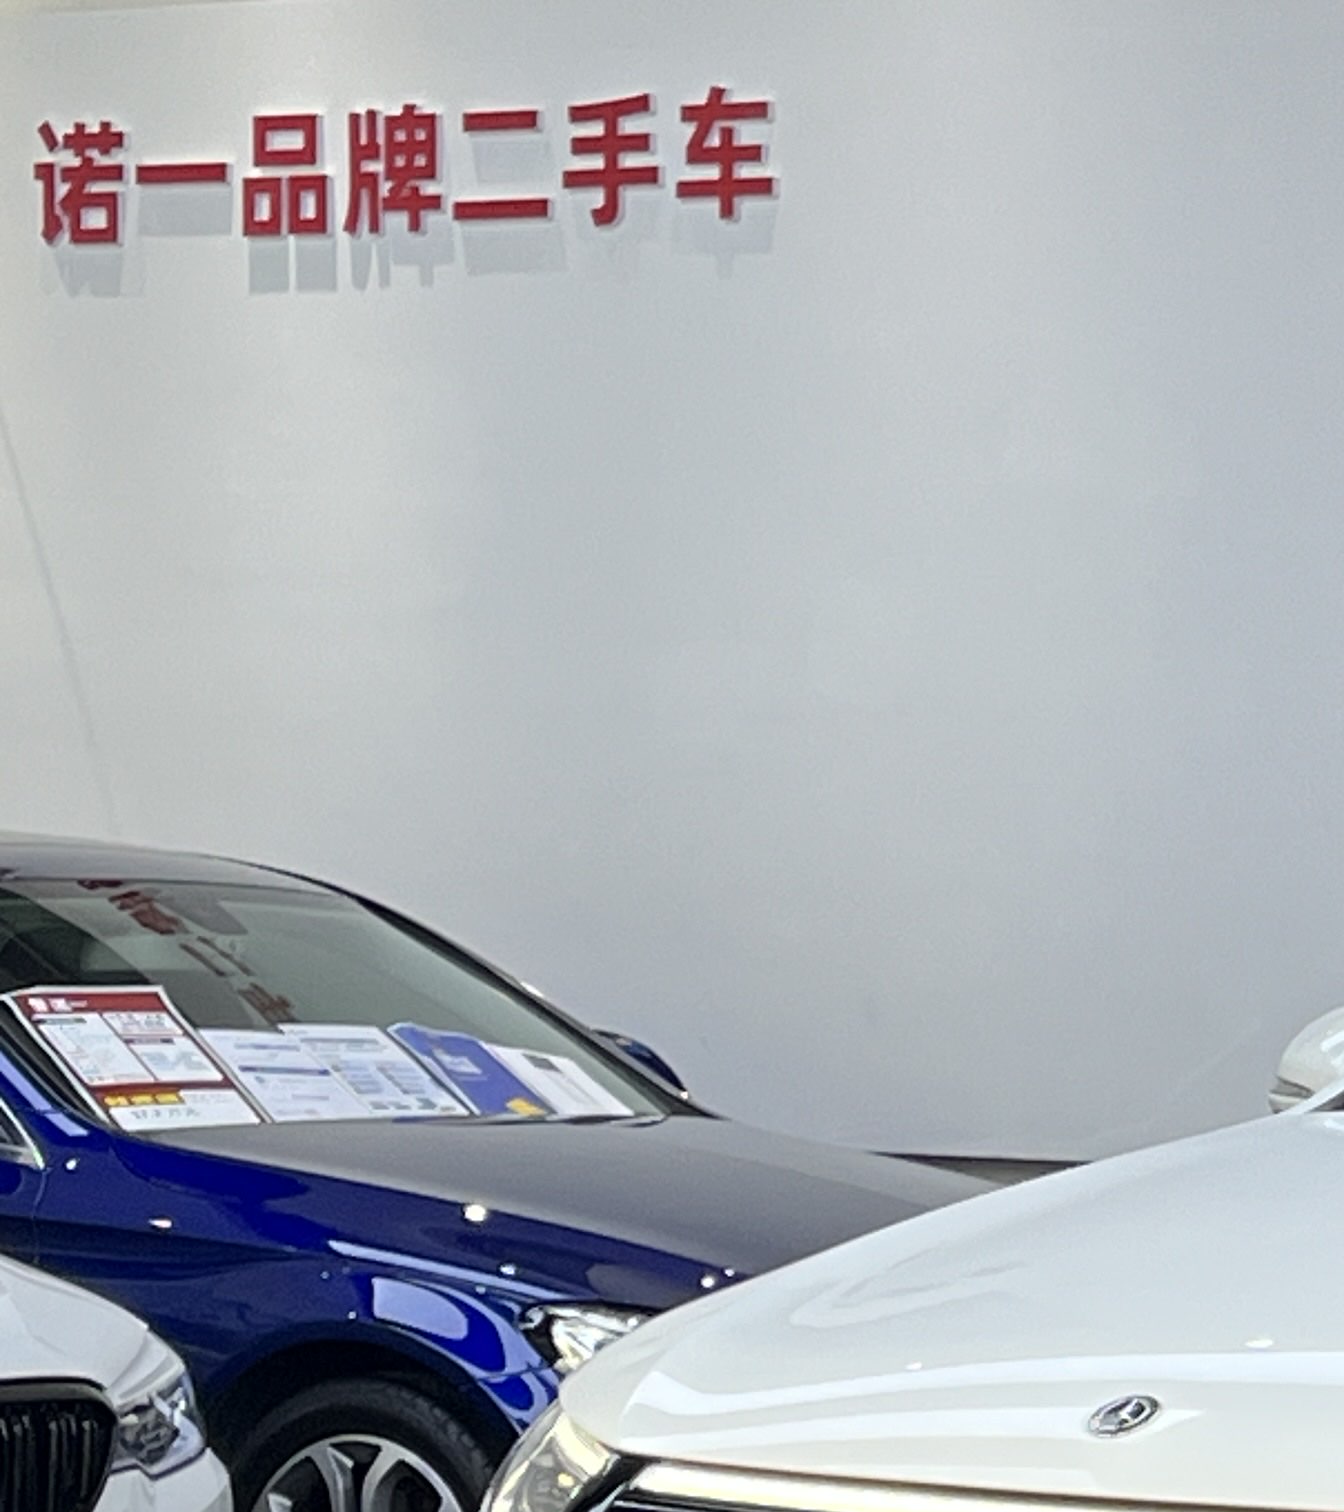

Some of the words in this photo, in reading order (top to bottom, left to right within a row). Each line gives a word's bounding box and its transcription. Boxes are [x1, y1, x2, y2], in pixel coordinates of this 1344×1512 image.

[33, 86, 779, 246] 诺一品牌二手车
